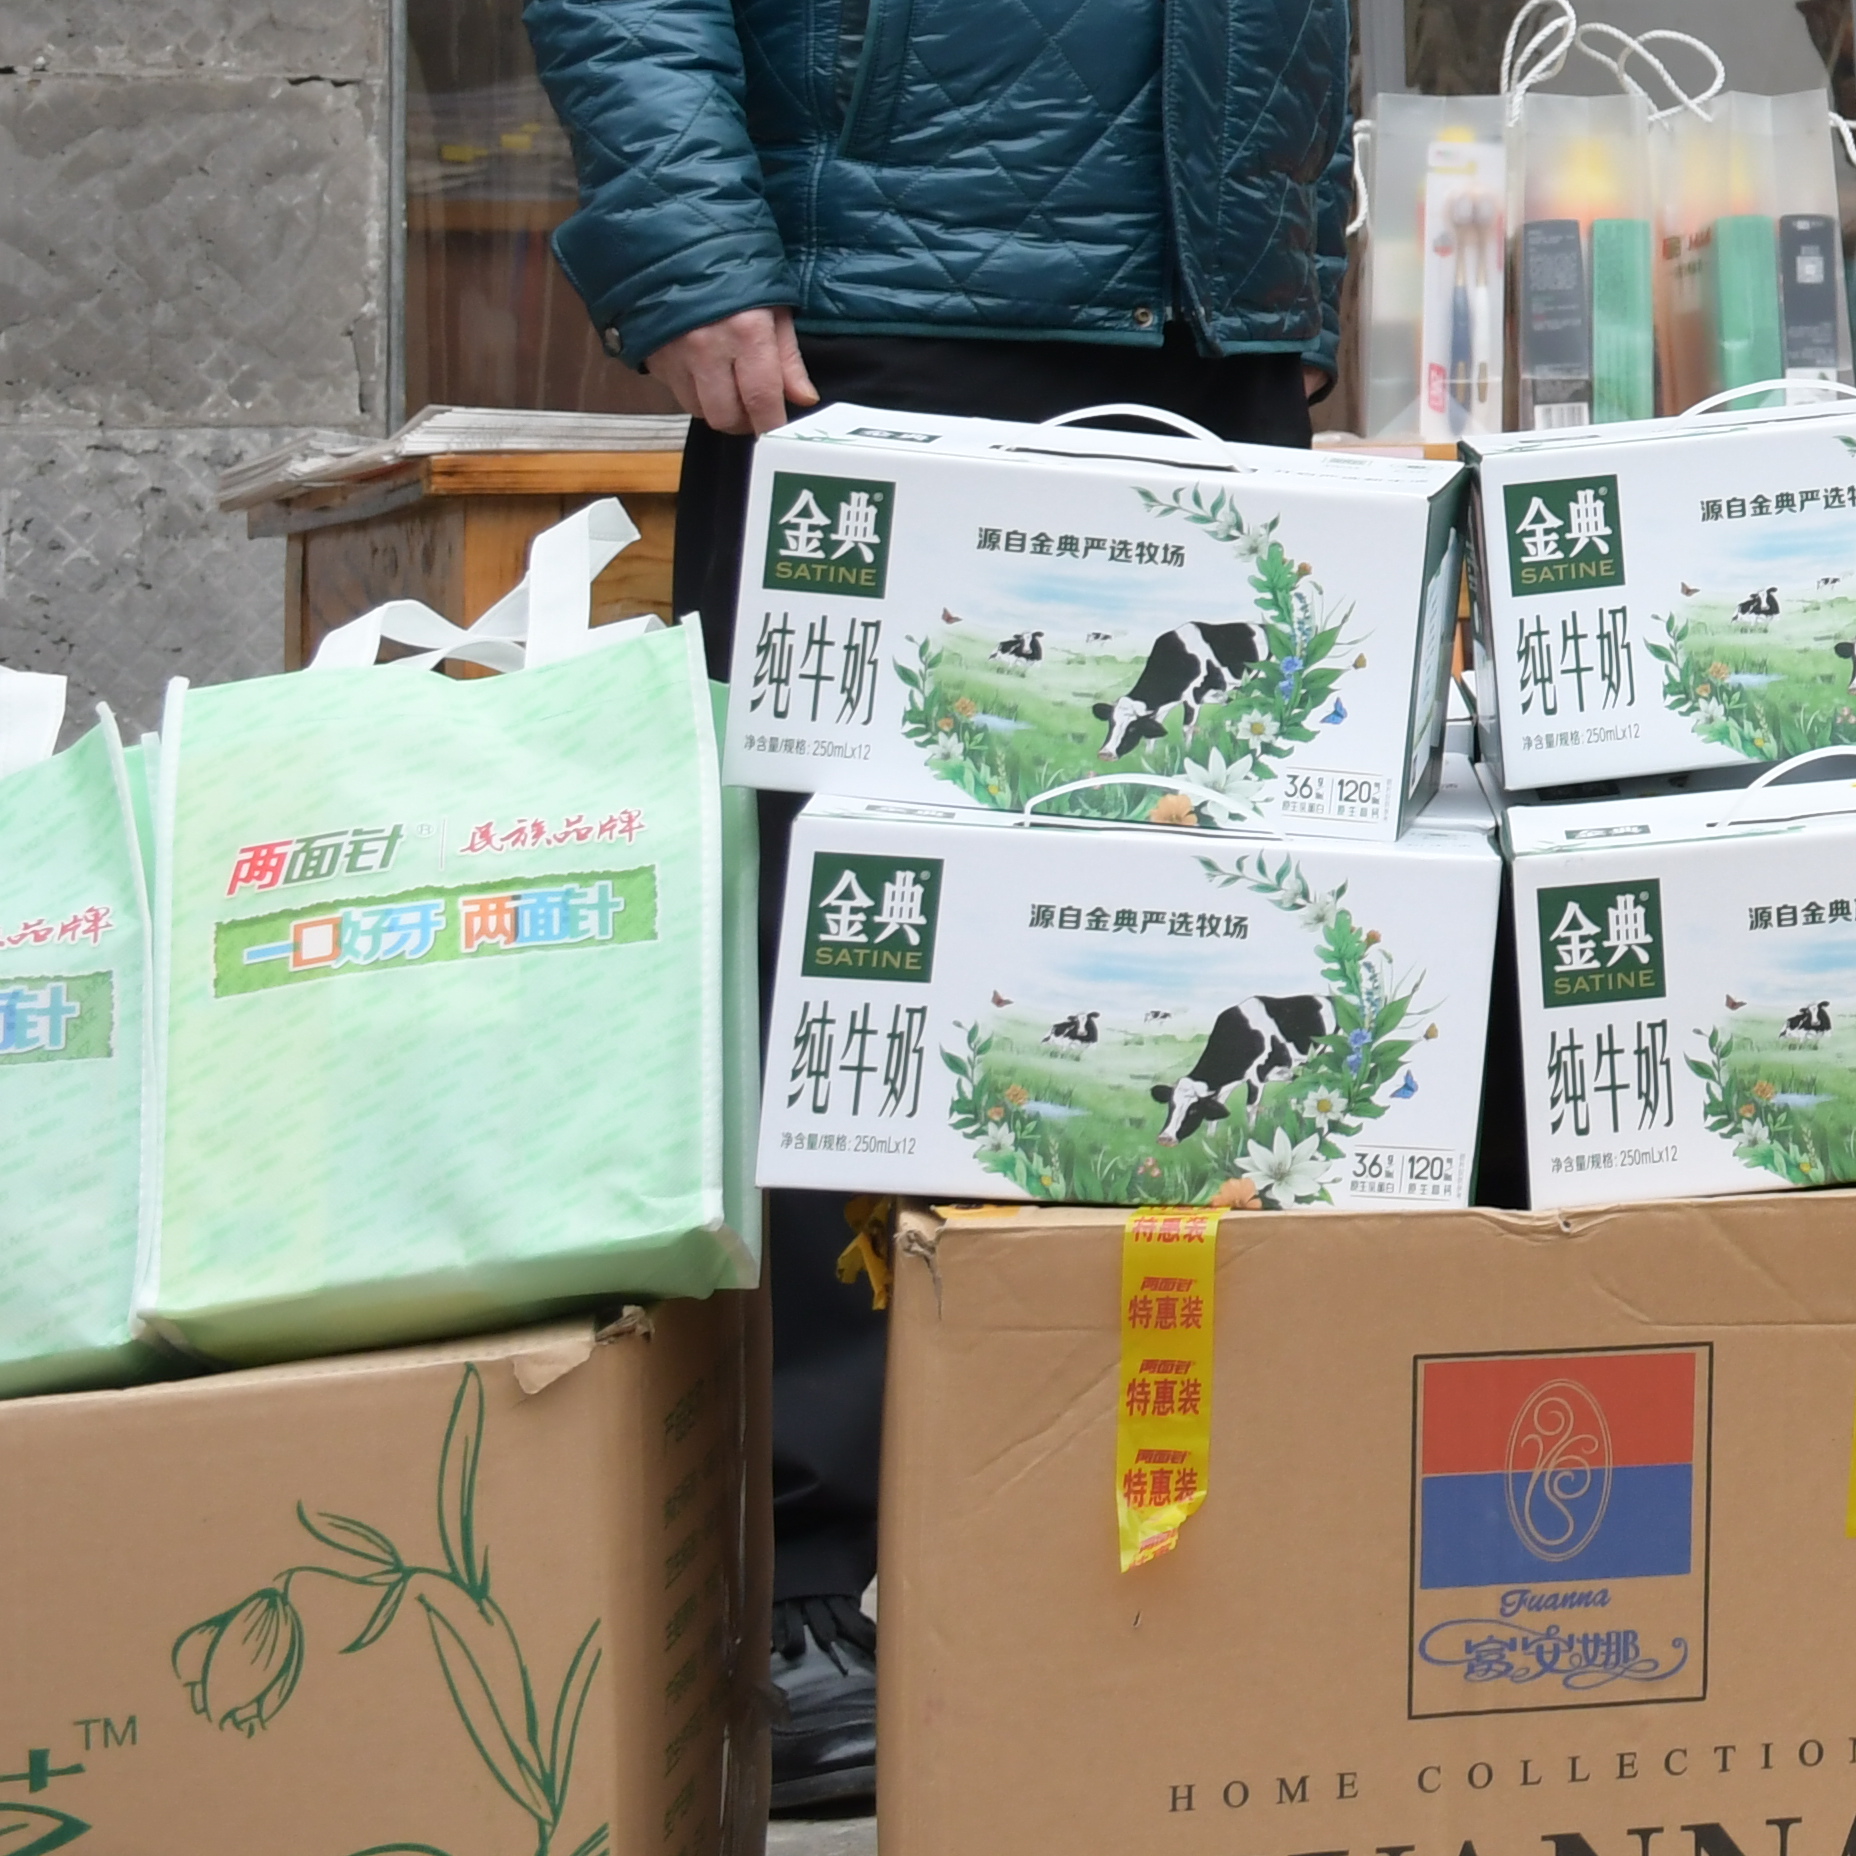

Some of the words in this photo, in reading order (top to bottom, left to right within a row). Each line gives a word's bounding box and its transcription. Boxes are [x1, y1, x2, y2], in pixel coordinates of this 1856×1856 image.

[779, 490, 882, 564] 金典
[976, 526, 1186, 568] 源自金典严选牧场
[1516, 487, 1614, 565] 金典
[774, 560, 877, 588] SATINE
[1520, 557, 1617, 586] SATINE
[749, 611, 883, 727] 纯牛奶
[1515, 605, 1637, 718] 纯牛奶
[460, 808, 645, 855] 民族品牌
[225, 823, 403, 898] 两面针
[0, 905, 113, 947] 品牌
[243, 897, 447, 971] 一口好牙
[462, 881, 625, 952] 两面针
[819, 868, 928, 946] 金典
[1028, 901, 1250, 942] 源自金典严选牧场
[1548, 892, 1656, 974] 金典
[814, 946, 924, 973] SATINE
[1552, 968, 1657, 996] SATINE
[787, 999, 928, 1119] 纯牛奶
[1547, 1017, 1674, 1138] 纯牛奶
[1132, 1213, 1207, 1244] 特惠装
[1127, 1294, 1204, 1331] 特惠装
[1126, 1376, 1202, 1418] 特惠装
[1122, 1466, 1199, 1508] 特惠装
[1440, 1622, 1665, 1689] 富安娜
[73, 1716, 138, 1750] TM
[1168, 1770, 1360, 1812] HOME
